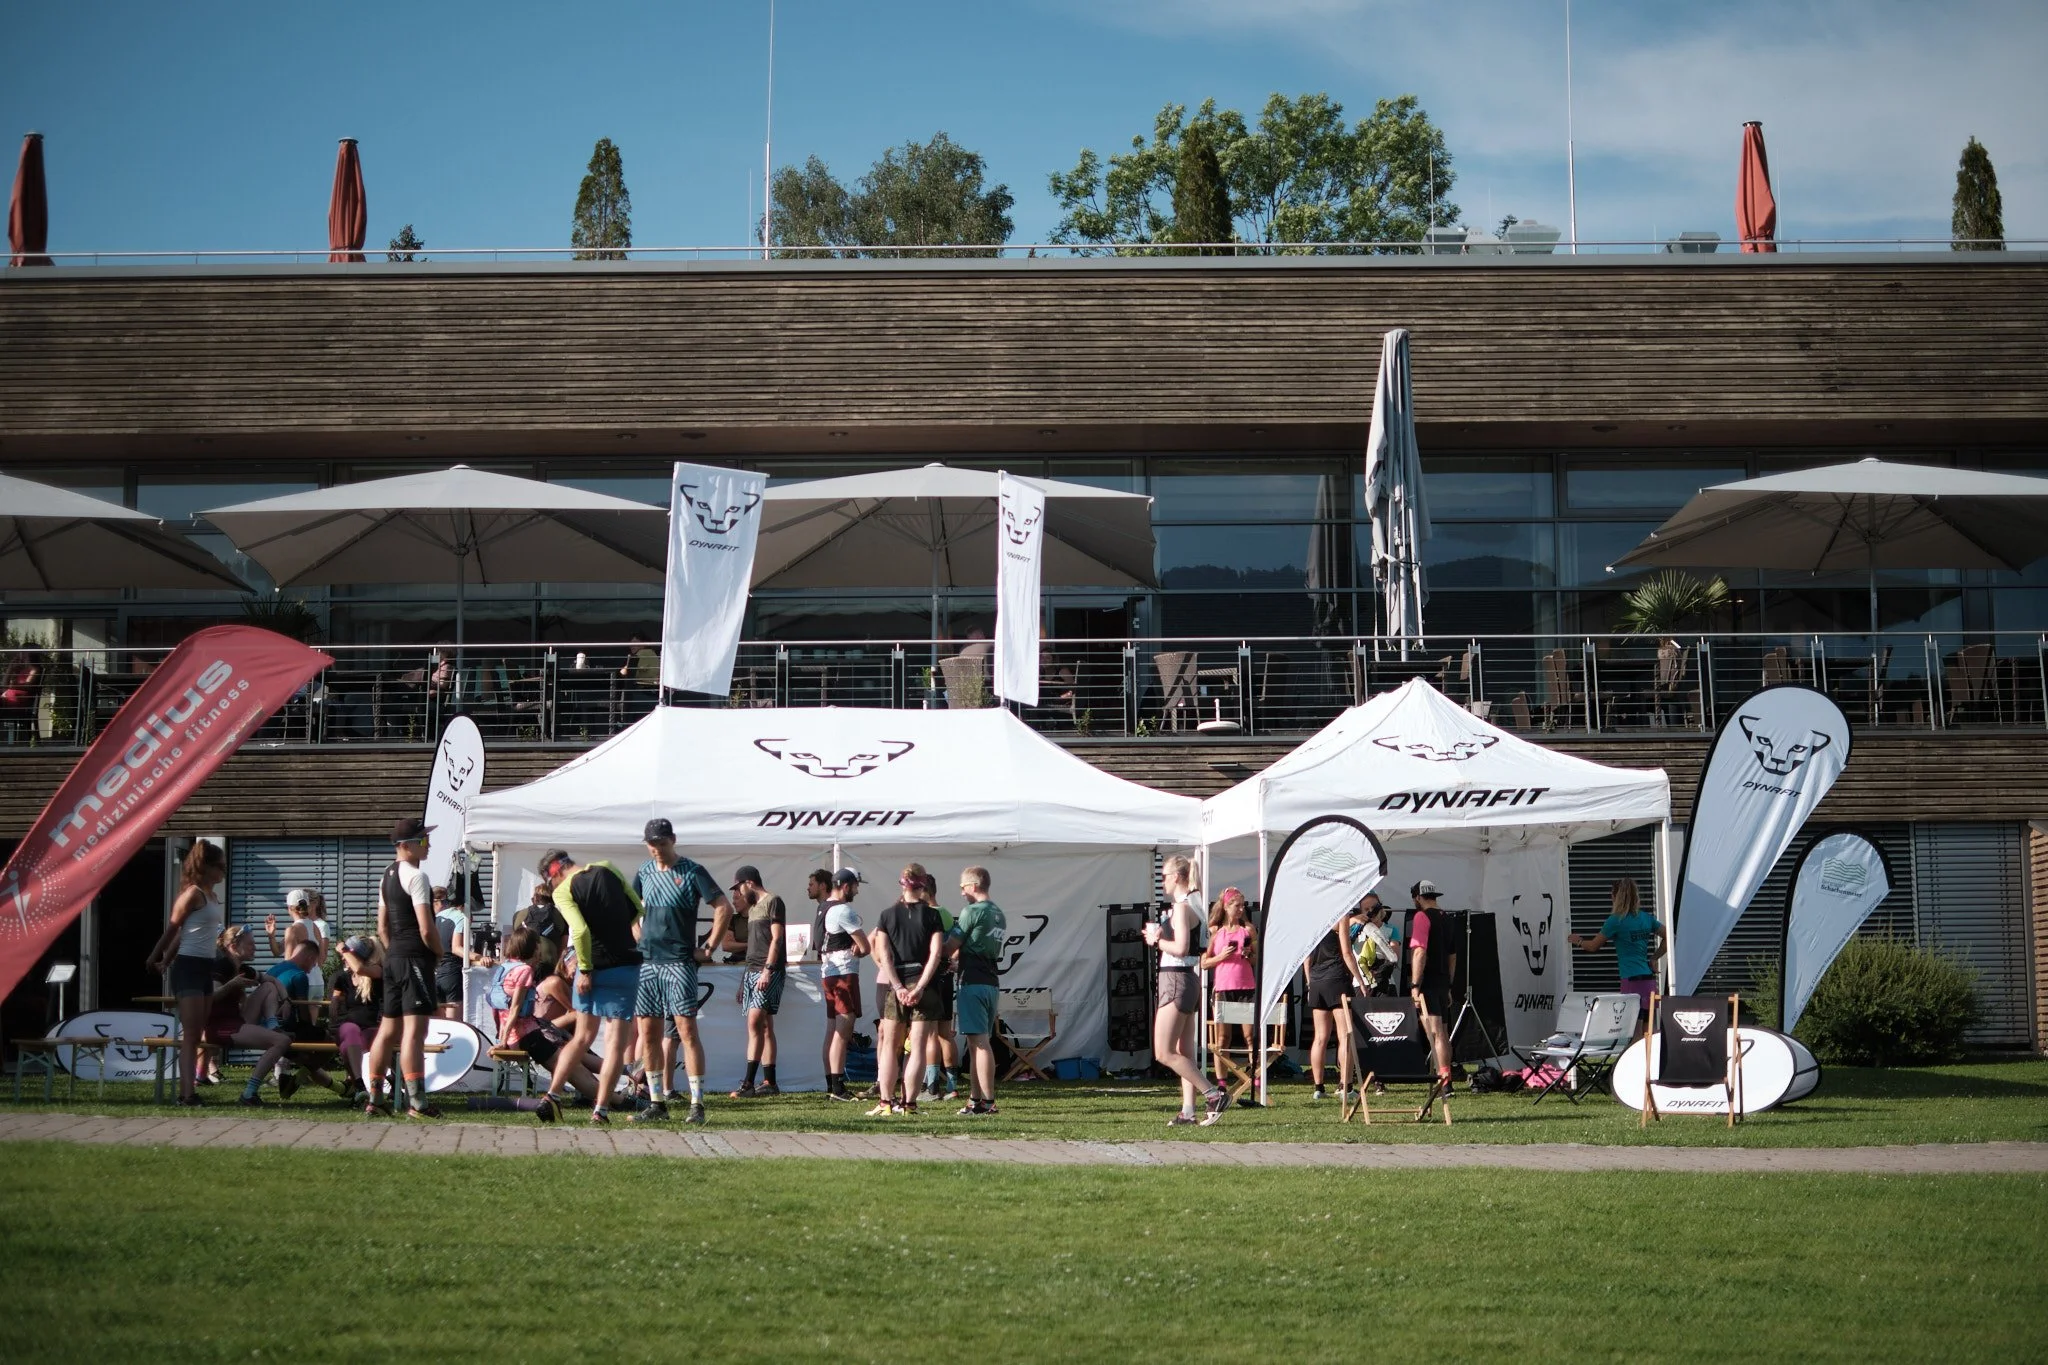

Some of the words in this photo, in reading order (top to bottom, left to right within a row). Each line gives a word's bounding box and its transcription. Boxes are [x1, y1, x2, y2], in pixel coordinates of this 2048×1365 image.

[689, 540, 740, 552] DYNAFIT
[48, 659, 233, 848] medius
[72, 747, 183, 861] medizinische
[184, 679, 250, 742] fitness
[1742, 781, 1802, 798] DYNAFIT
[1377, 787, 1550, 813] DYNAFIT
[757, 811, 915, 830] DYNAFIT
[1515, 993, 1555, 1012] DYNAFIT
[1368, 1035, 1408, 1043] DYNAFIT
[1666, 1100, 1728, 1109] DYNAFIT
